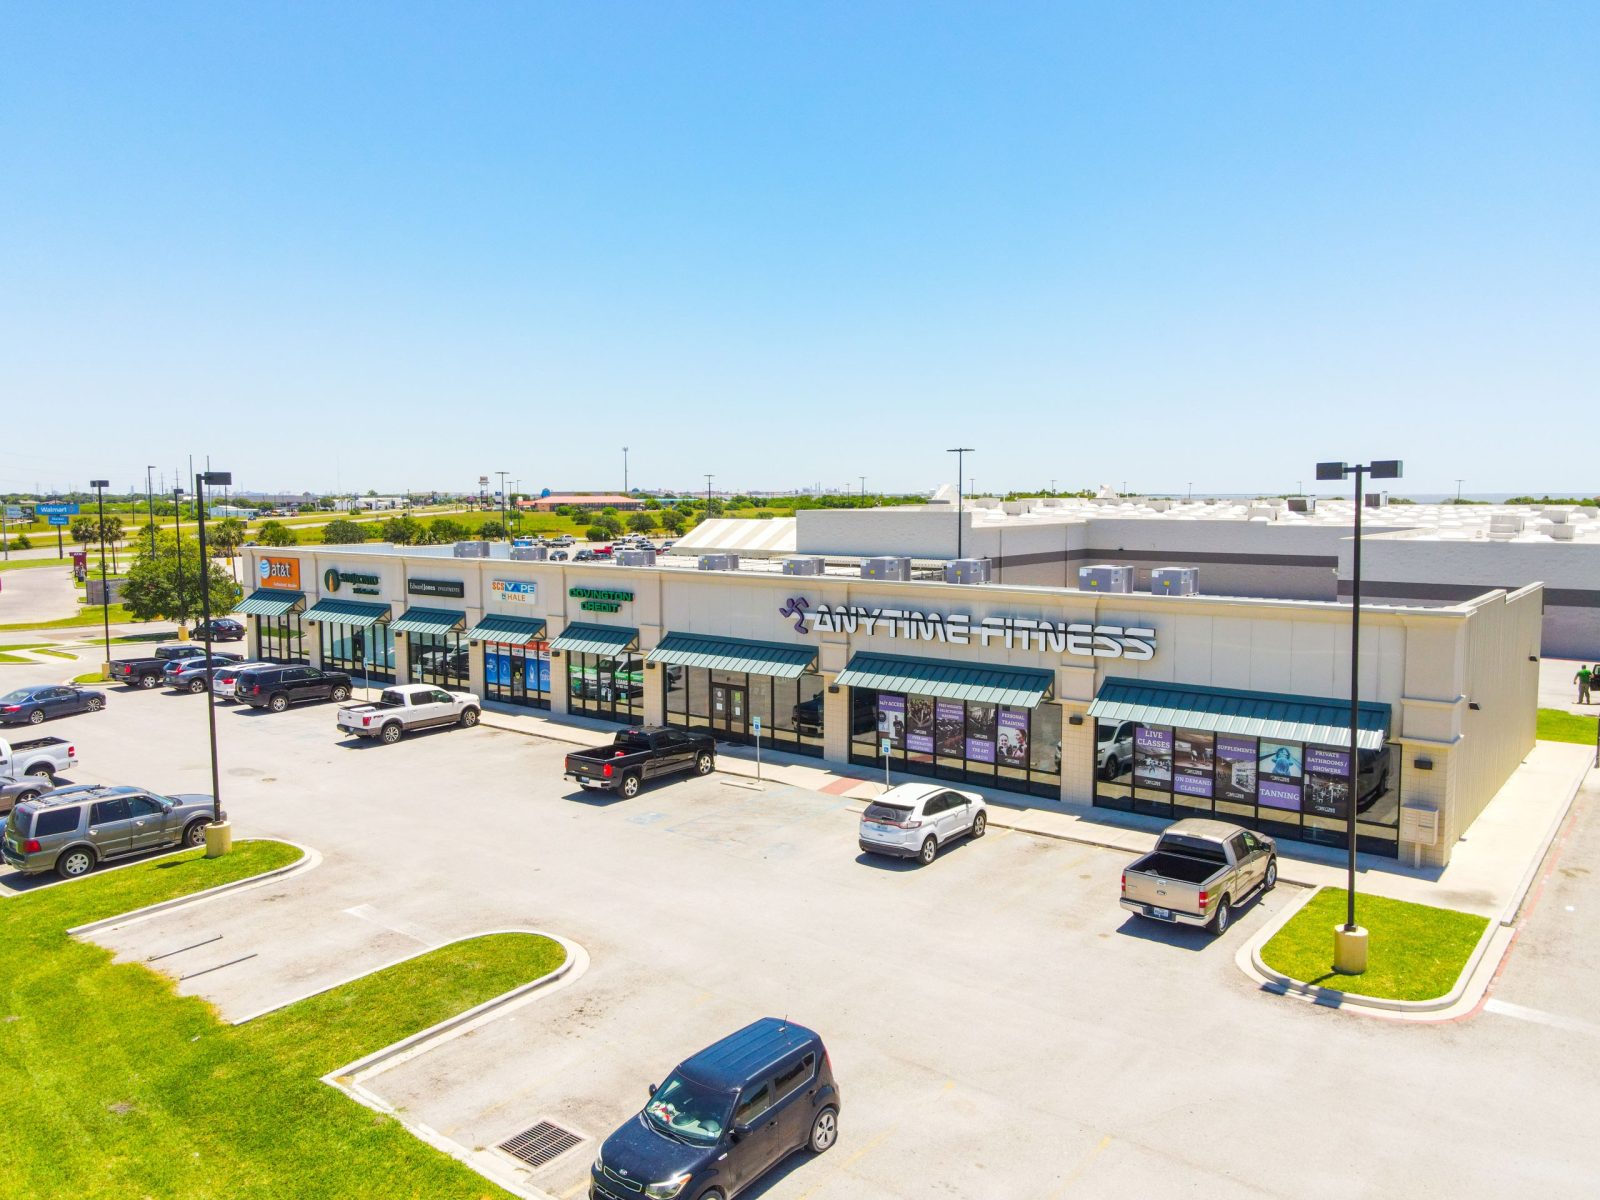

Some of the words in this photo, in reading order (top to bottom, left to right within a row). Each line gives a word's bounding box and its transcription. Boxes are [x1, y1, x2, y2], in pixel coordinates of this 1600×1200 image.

[271, 562, 290, 577] at&t
[423, 583, 436, 591] Jones
[569, 588, 634, 602] COVINGTON
[581, 601, 620, 613] CREDIT
[812, 604, 970, 645] ANYTIME
[981, 615, 1156, 661] FITNESS
[1001, 712, 1025, 720] PERSONAL
[1145, 730, 1163, 738] LIVE
[1137, 738, 1170, 748] CLASSES
[1217, 744, 1256, 754] SUPPLEMENTS
[1315, 750, 1340, 758] PRIVATE
[1307, 757, 1344, 766] BATHROOMS
[1312, 765, 1341, 774] SHOWERS
[1184, 777, 1212, 786] DEMAND
[1180, 785, 1206, 793] CLASSES
[1260, 788, 1300, 801] TANNING
